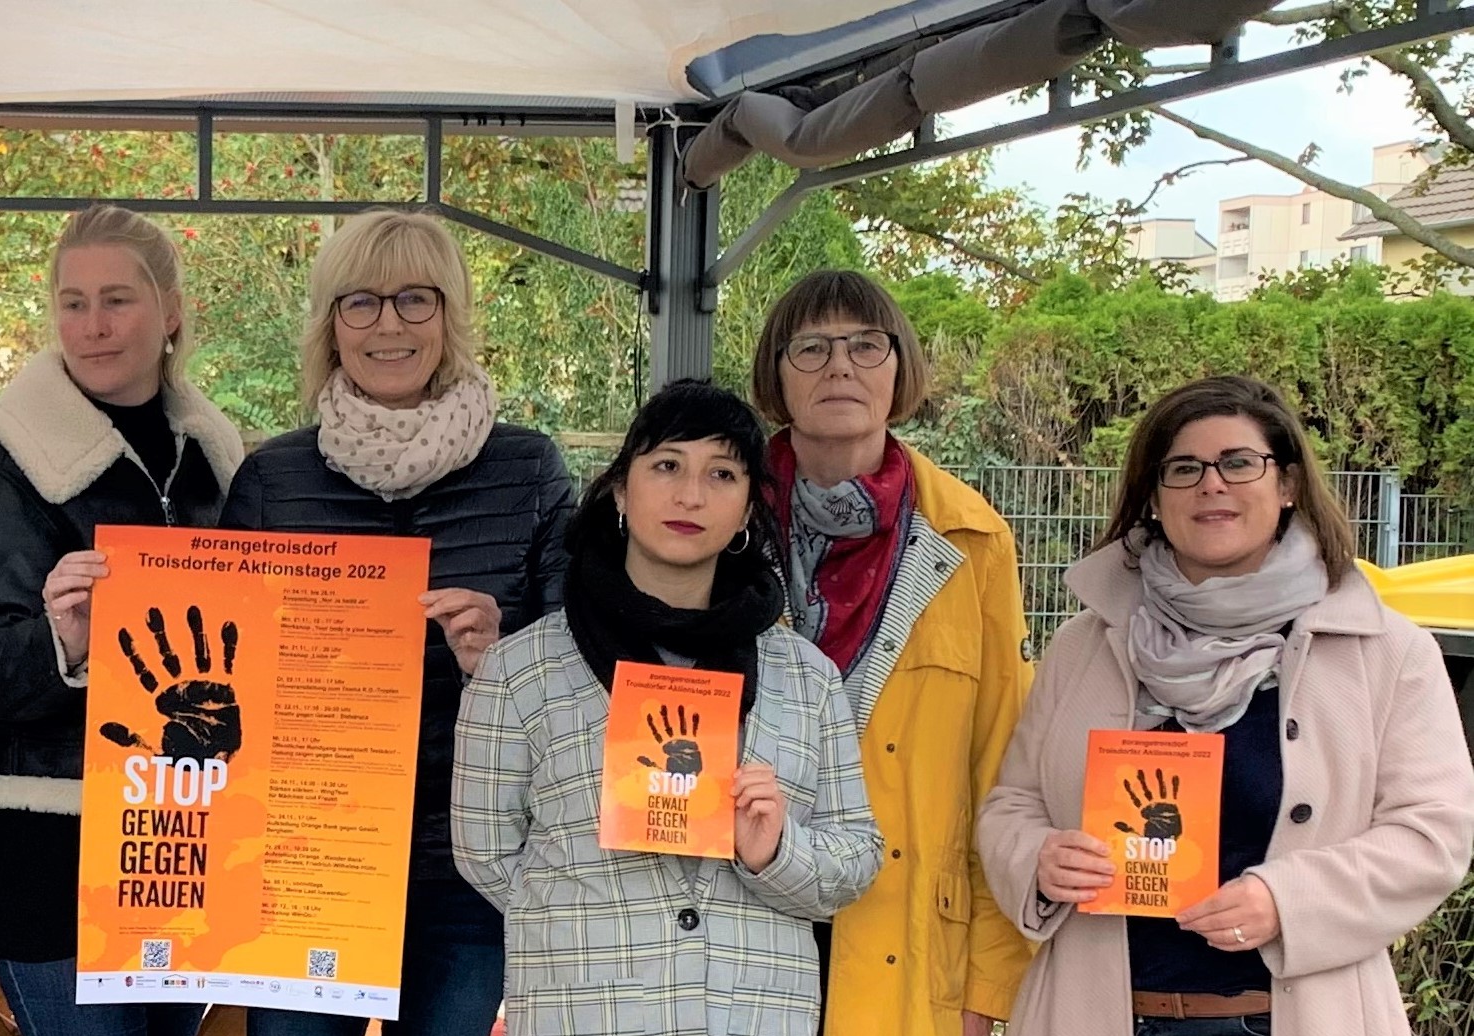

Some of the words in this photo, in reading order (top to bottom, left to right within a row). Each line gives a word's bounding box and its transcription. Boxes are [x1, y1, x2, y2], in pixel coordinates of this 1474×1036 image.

[190, 536, 337, 556] #orangetroisdorf
[138, 553, 233, 573] Troisdorfer
[238, 558, 342, 581] Aktionstage
[347, 564, 386, 580] 2022
[123, 754, 228, 807] STOP
[648, 771, 698, 797] STOP
[648, 795, 689, 811] GEWALT
[122, 808, 209, 839] GEWALT
[647, 810, 688, 830] GEGEN
[646, 828, 687, 844] FRAUEN
[120, 841, 207, 876] GEGEN
[1125, 836, 1177, 861] STOP
[1125, 861, 1168, 876] GEWALT
[118, 879, 205, 909] FRAUEN
[1125, 875, 1169, 892] GEGEN
[1124, 891, 1169, 907] FRAUEN
